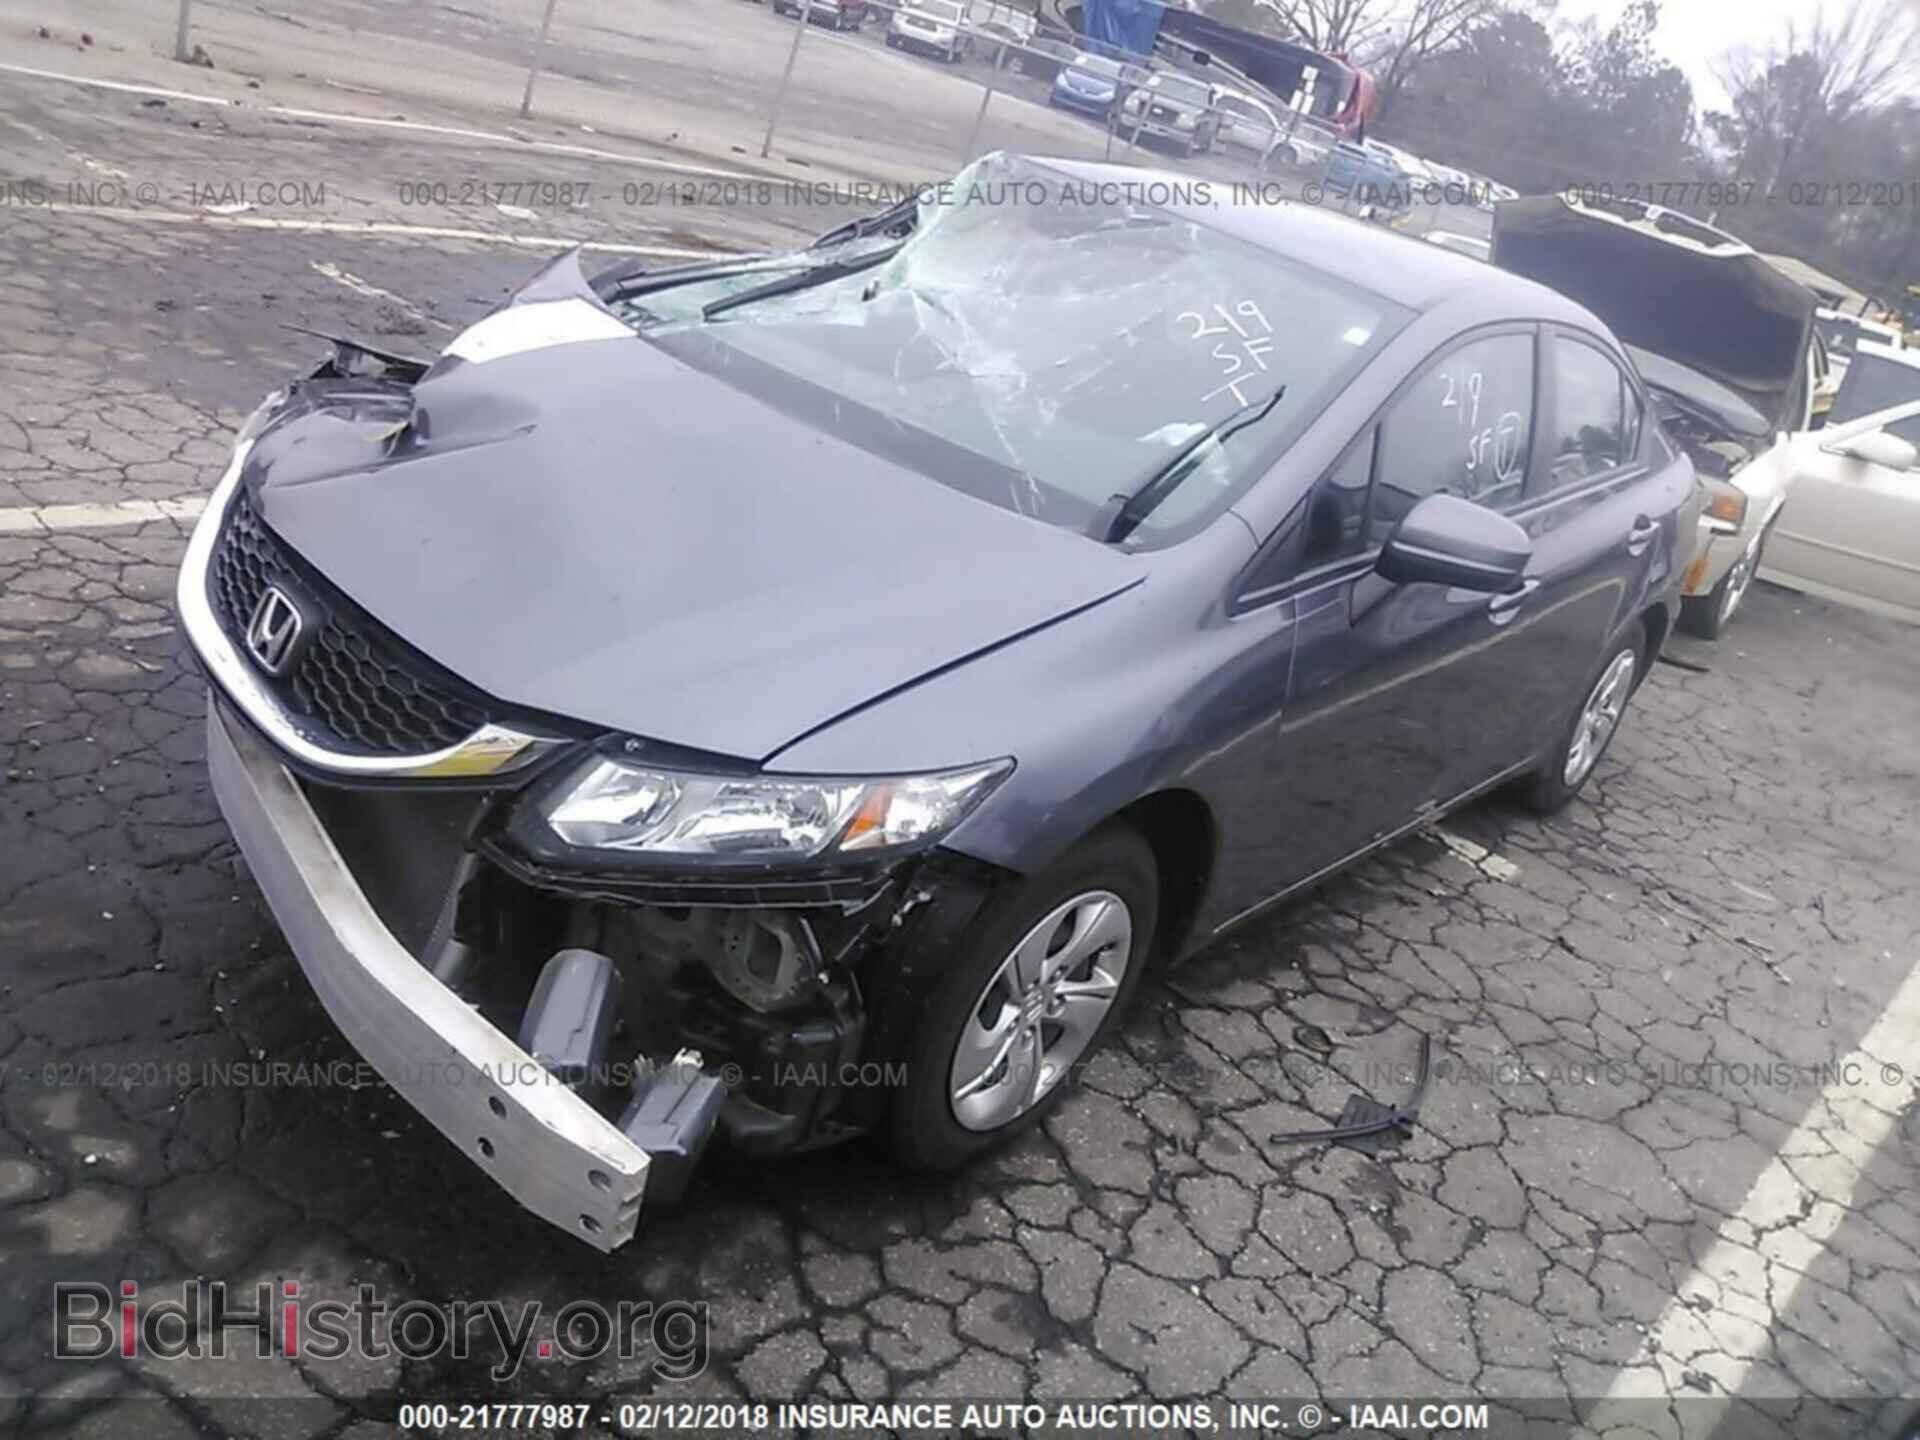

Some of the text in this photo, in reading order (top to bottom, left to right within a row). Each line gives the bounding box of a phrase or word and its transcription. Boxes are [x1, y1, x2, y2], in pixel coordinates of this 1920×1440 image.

[1176, 300, 1273, 340] 219
[1211, 338, 1274, 374] SF
[1439, 371, 1483, 427] 219
